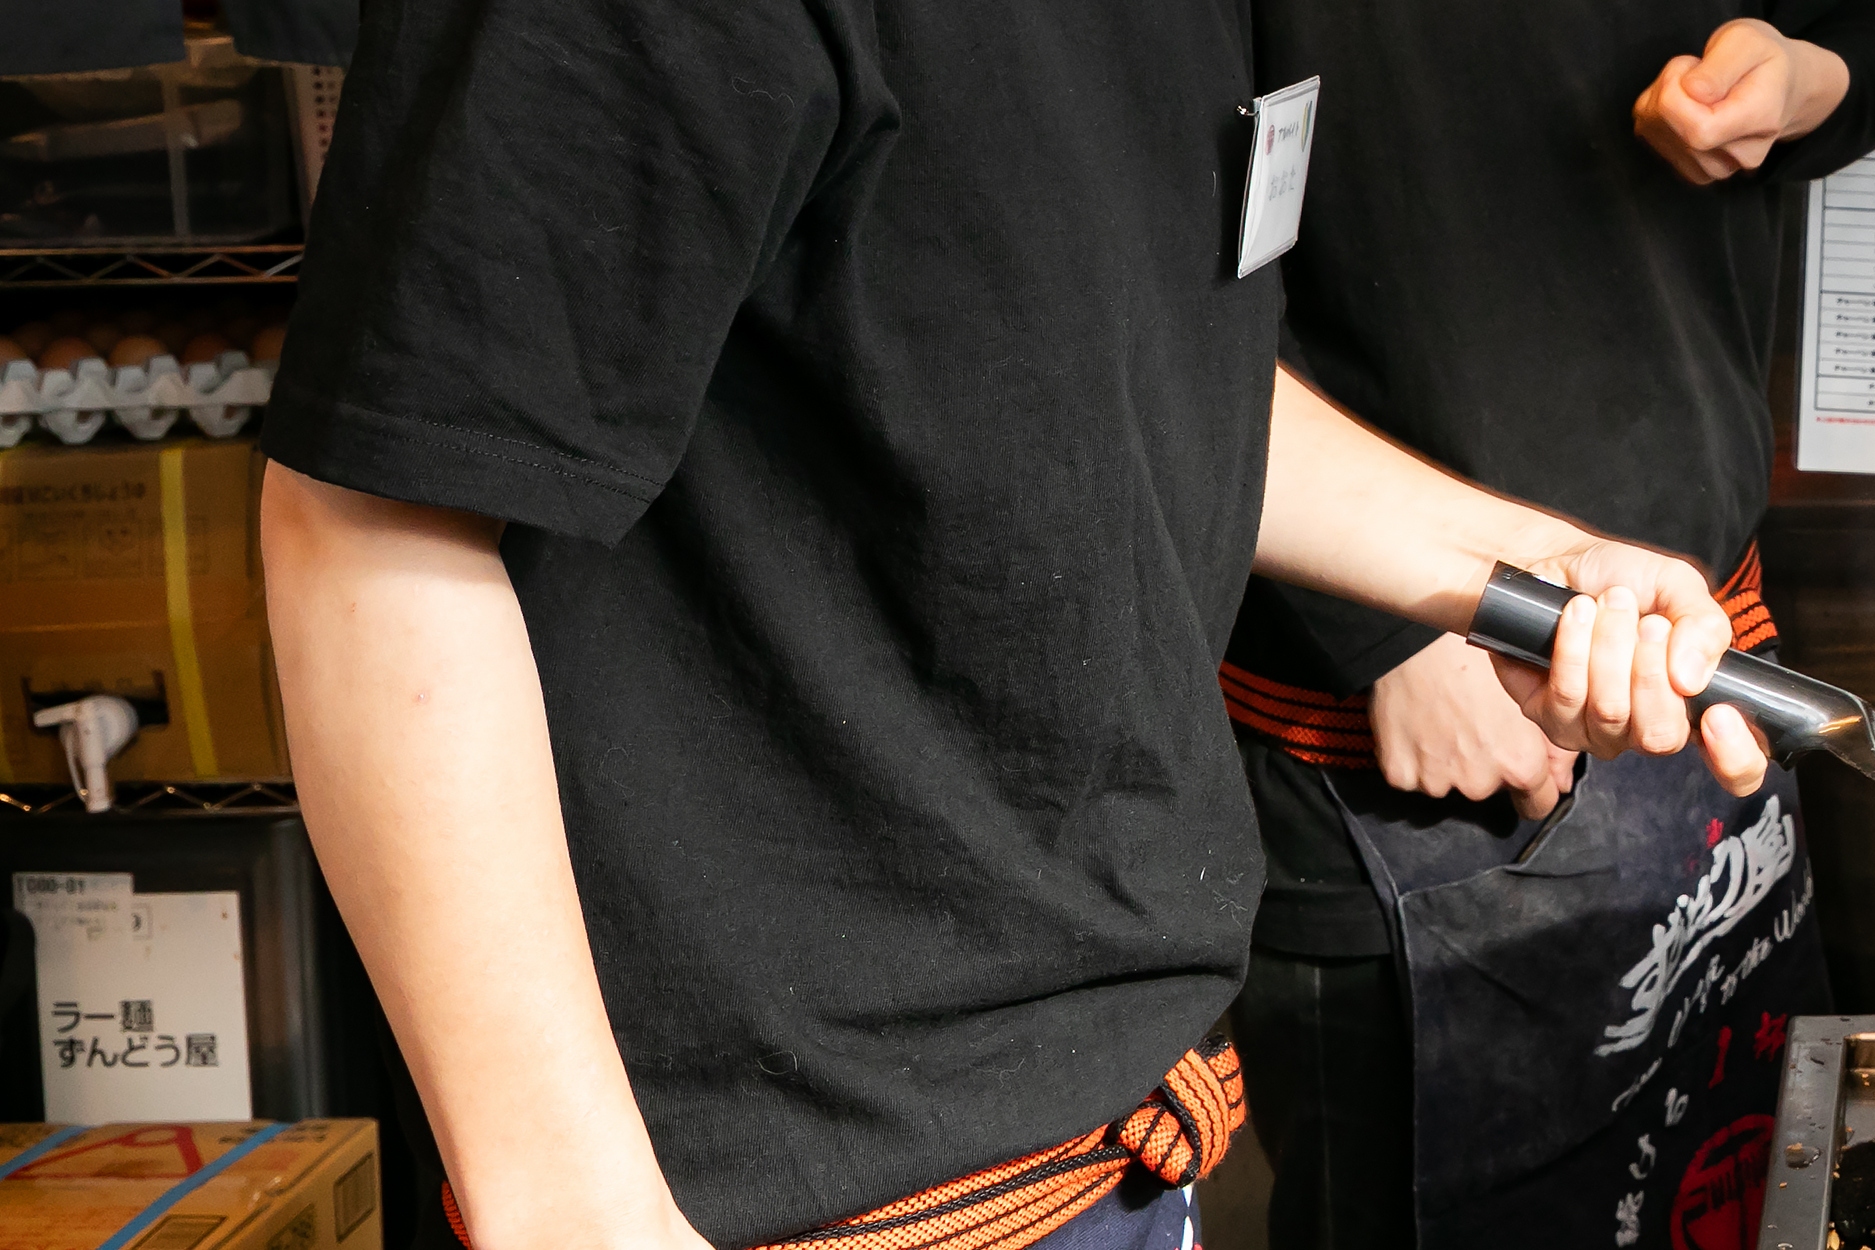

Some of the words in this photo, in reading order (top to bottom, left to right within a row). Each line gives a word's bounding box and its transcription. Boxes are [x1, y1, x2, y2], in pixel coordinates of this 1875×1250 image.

[51, 999, 153, 1032] ラー麺
[53, 1034, 218, 1067] ずんどう屋
